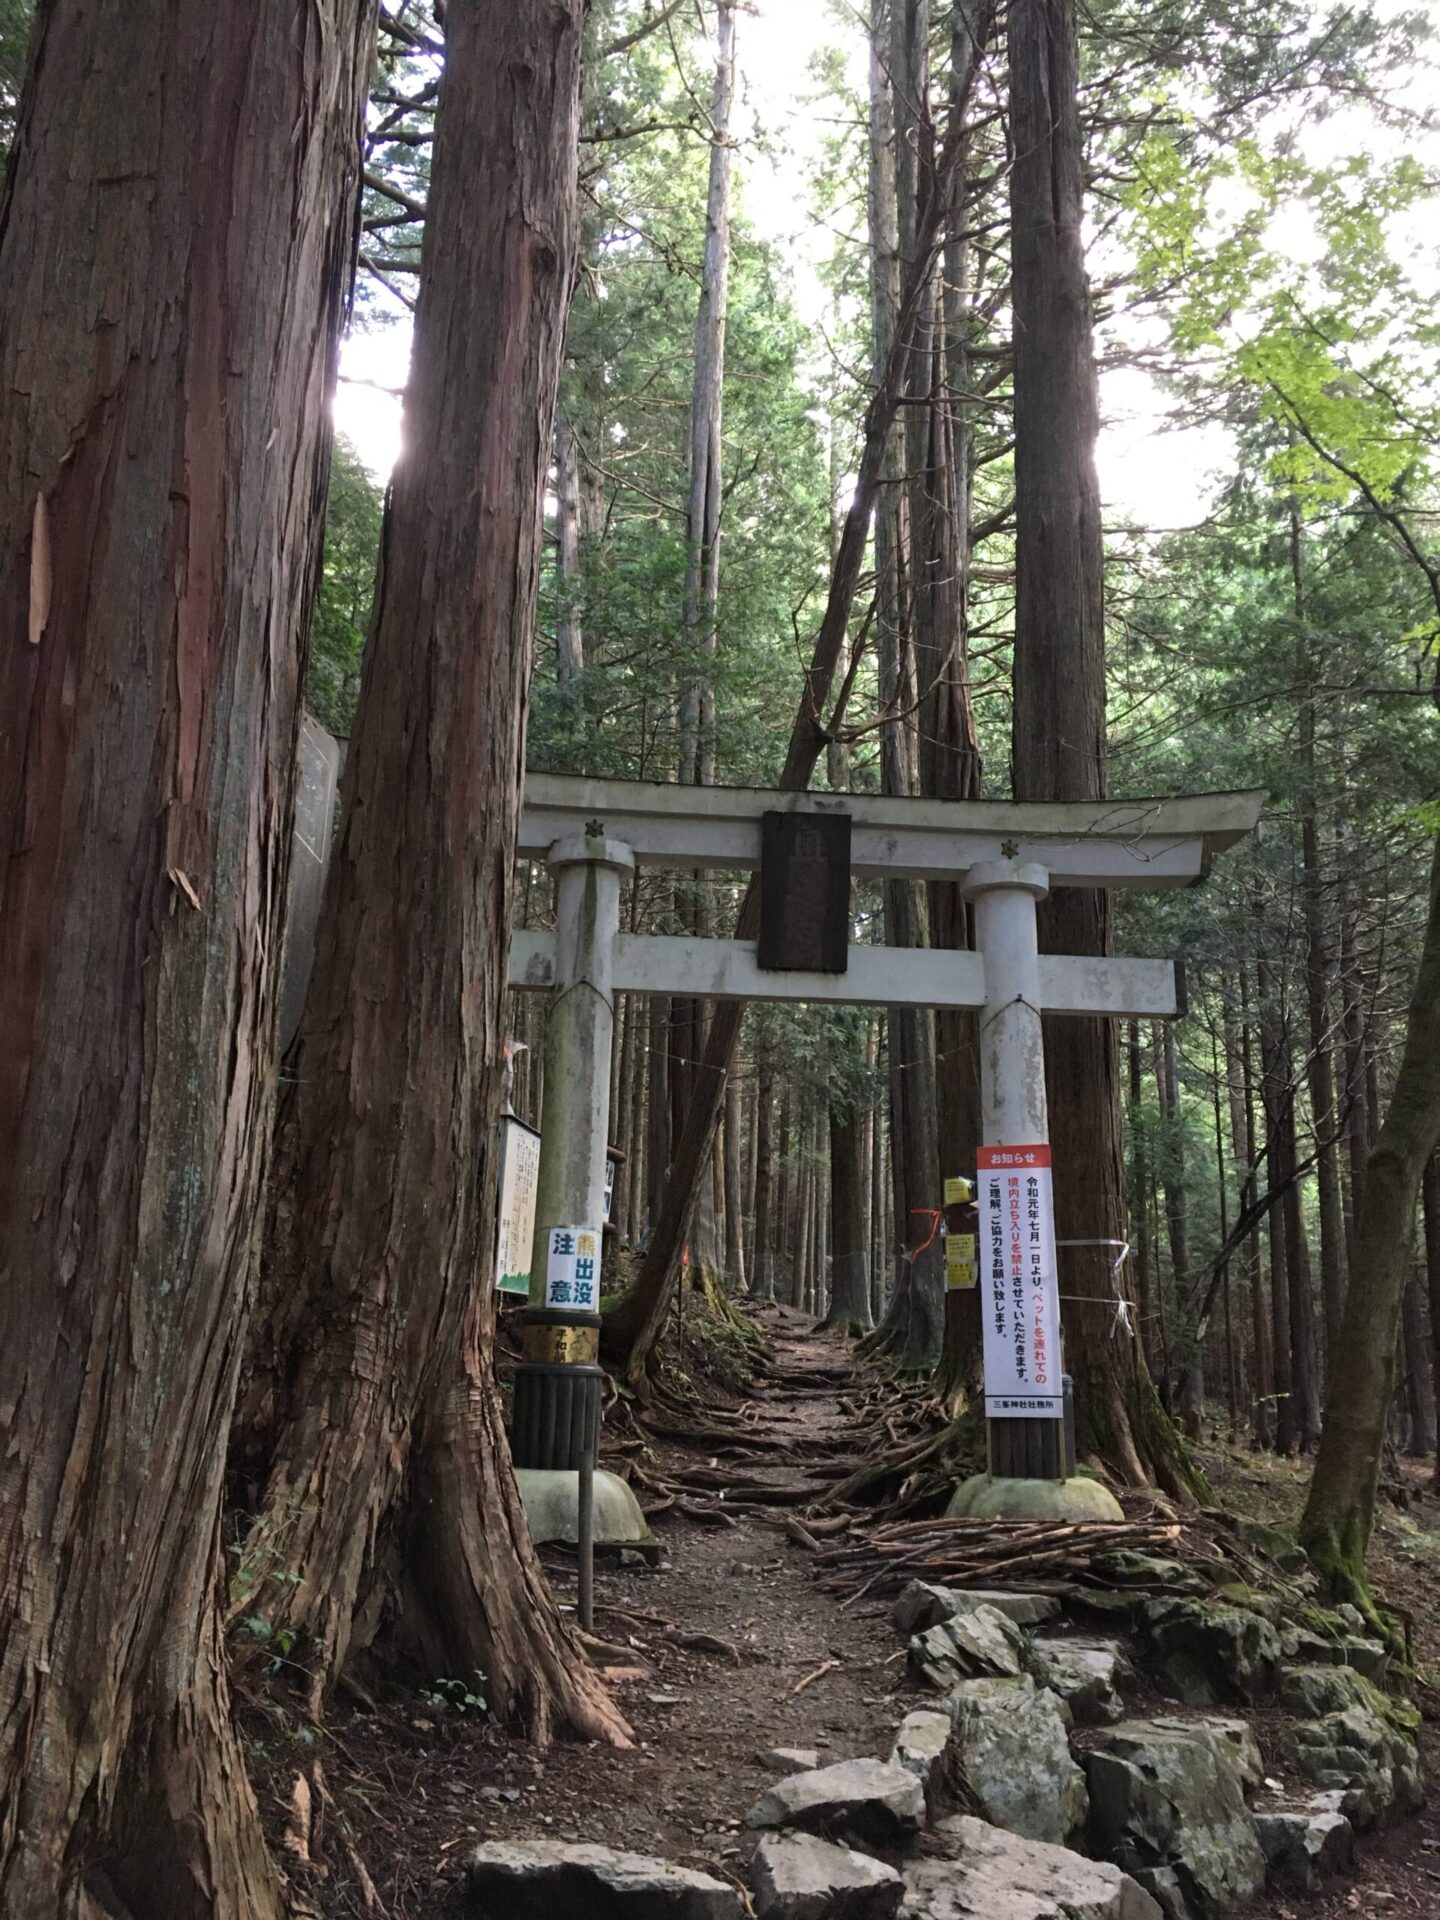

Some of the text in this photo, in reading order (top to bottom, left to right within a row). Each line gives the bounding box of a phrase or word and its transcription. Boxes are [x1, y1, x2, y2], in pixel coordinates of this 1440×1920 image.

[991, 1152, 1036, 1164] お知らせ
[550, 1233, 575, 1303] 注意
[573, 1233, 596, 1304] 熊出没
[989, 1177, 1007, 1338] ご理解、ご協力をお願い致します。
[1008, 1177, 1028, 1383] 境内立ち入りを禁止させていただきます。
